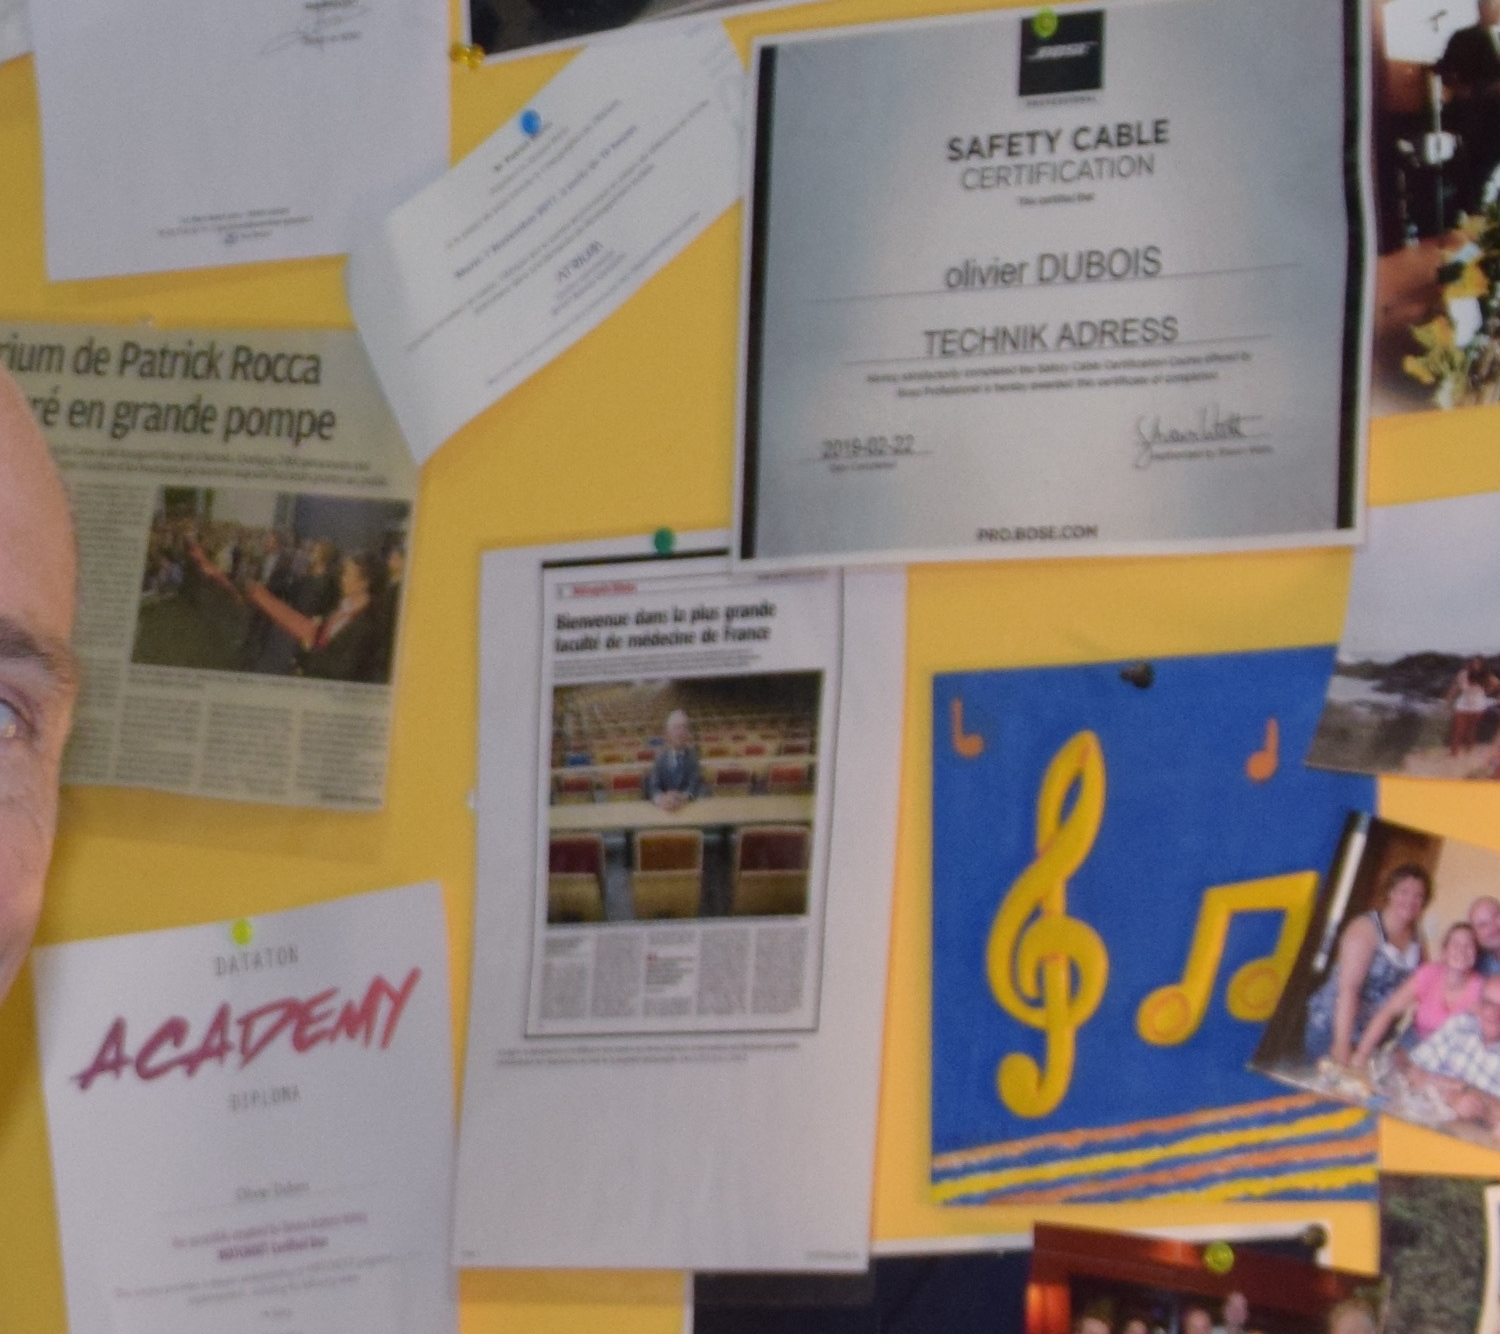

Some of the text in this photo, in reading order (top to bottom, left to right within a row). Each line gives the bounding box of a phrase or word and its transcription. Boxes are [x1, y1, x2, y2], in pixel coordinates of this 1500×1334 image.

[946, 118, 1171, 164] SAFETY CABLE
[961, 153, 1157, 193] CERTIFICATION
[945, 245, 1163, 291] olivier DUBOIS
[924, 315, 1180, 359] TECHNIK ADRESS
[74, 335, 109, 377] de
[119, 339, 222, 381] Patrick
[231, 349, 323, 386] Rocca
[68, 393, 337, 447] en grande pompe
[976, 525, 1099, 542] PRO.BOSE.COM
[556, 599, 776, 633] Bienvenue dans la plus grande
[606, 633, 623, 651] de
[628, 627, 697, 650] médecine
[701, 626, 719, 646] de
[723, 623, 772, 644] France
[213, 943, 301, 977] DATATON
[71, 967, 424, 1092] ACADEMY
[229, 1084, 303, 1113] DIPLOMA
